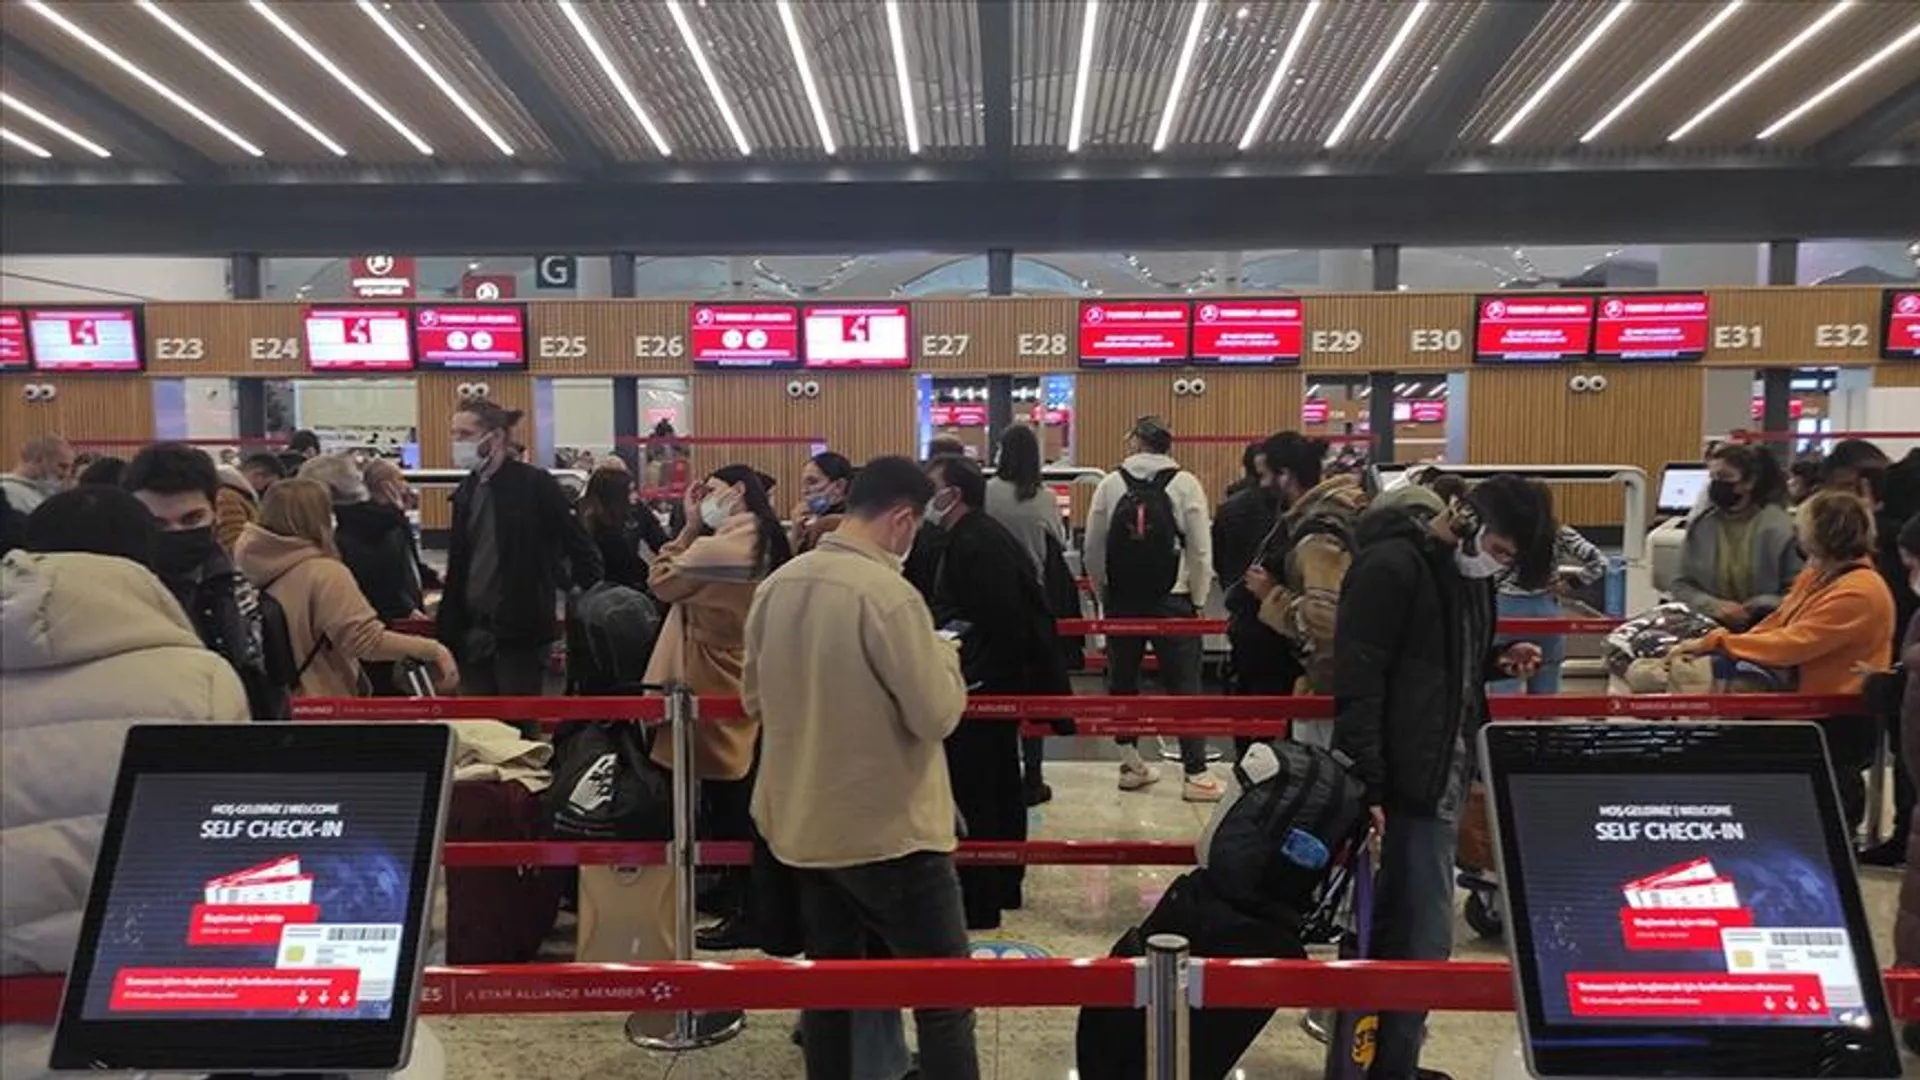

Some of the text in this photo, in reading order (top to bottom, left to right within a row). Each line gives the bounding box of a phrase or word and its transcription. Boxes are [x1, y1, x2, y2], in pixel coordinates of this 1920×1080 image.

[540, 255, 569, 285] G
[539, 335, 588, 357] E25
[635, 335, 684, 357] E26
[922, 334, 969, 356] E27
[1017, 333, 1067, 355] E28
[1311, 330, 1362, 352] E29
[1411, 329, 1462, 352] E30
[1714, 325, 1763, 348] E31
[1815, 324, 1868, 347] E32
[155, 337, 204, 360] E23
[250, 337, 300, 360] E24
[200, 819, 344, 838] SELF CHECK-IN
[1594, 821, 1745, 841] SELF CHECK-IN
[464, 986, 646, 1001] A STAR ALLIANCE MEMBER
